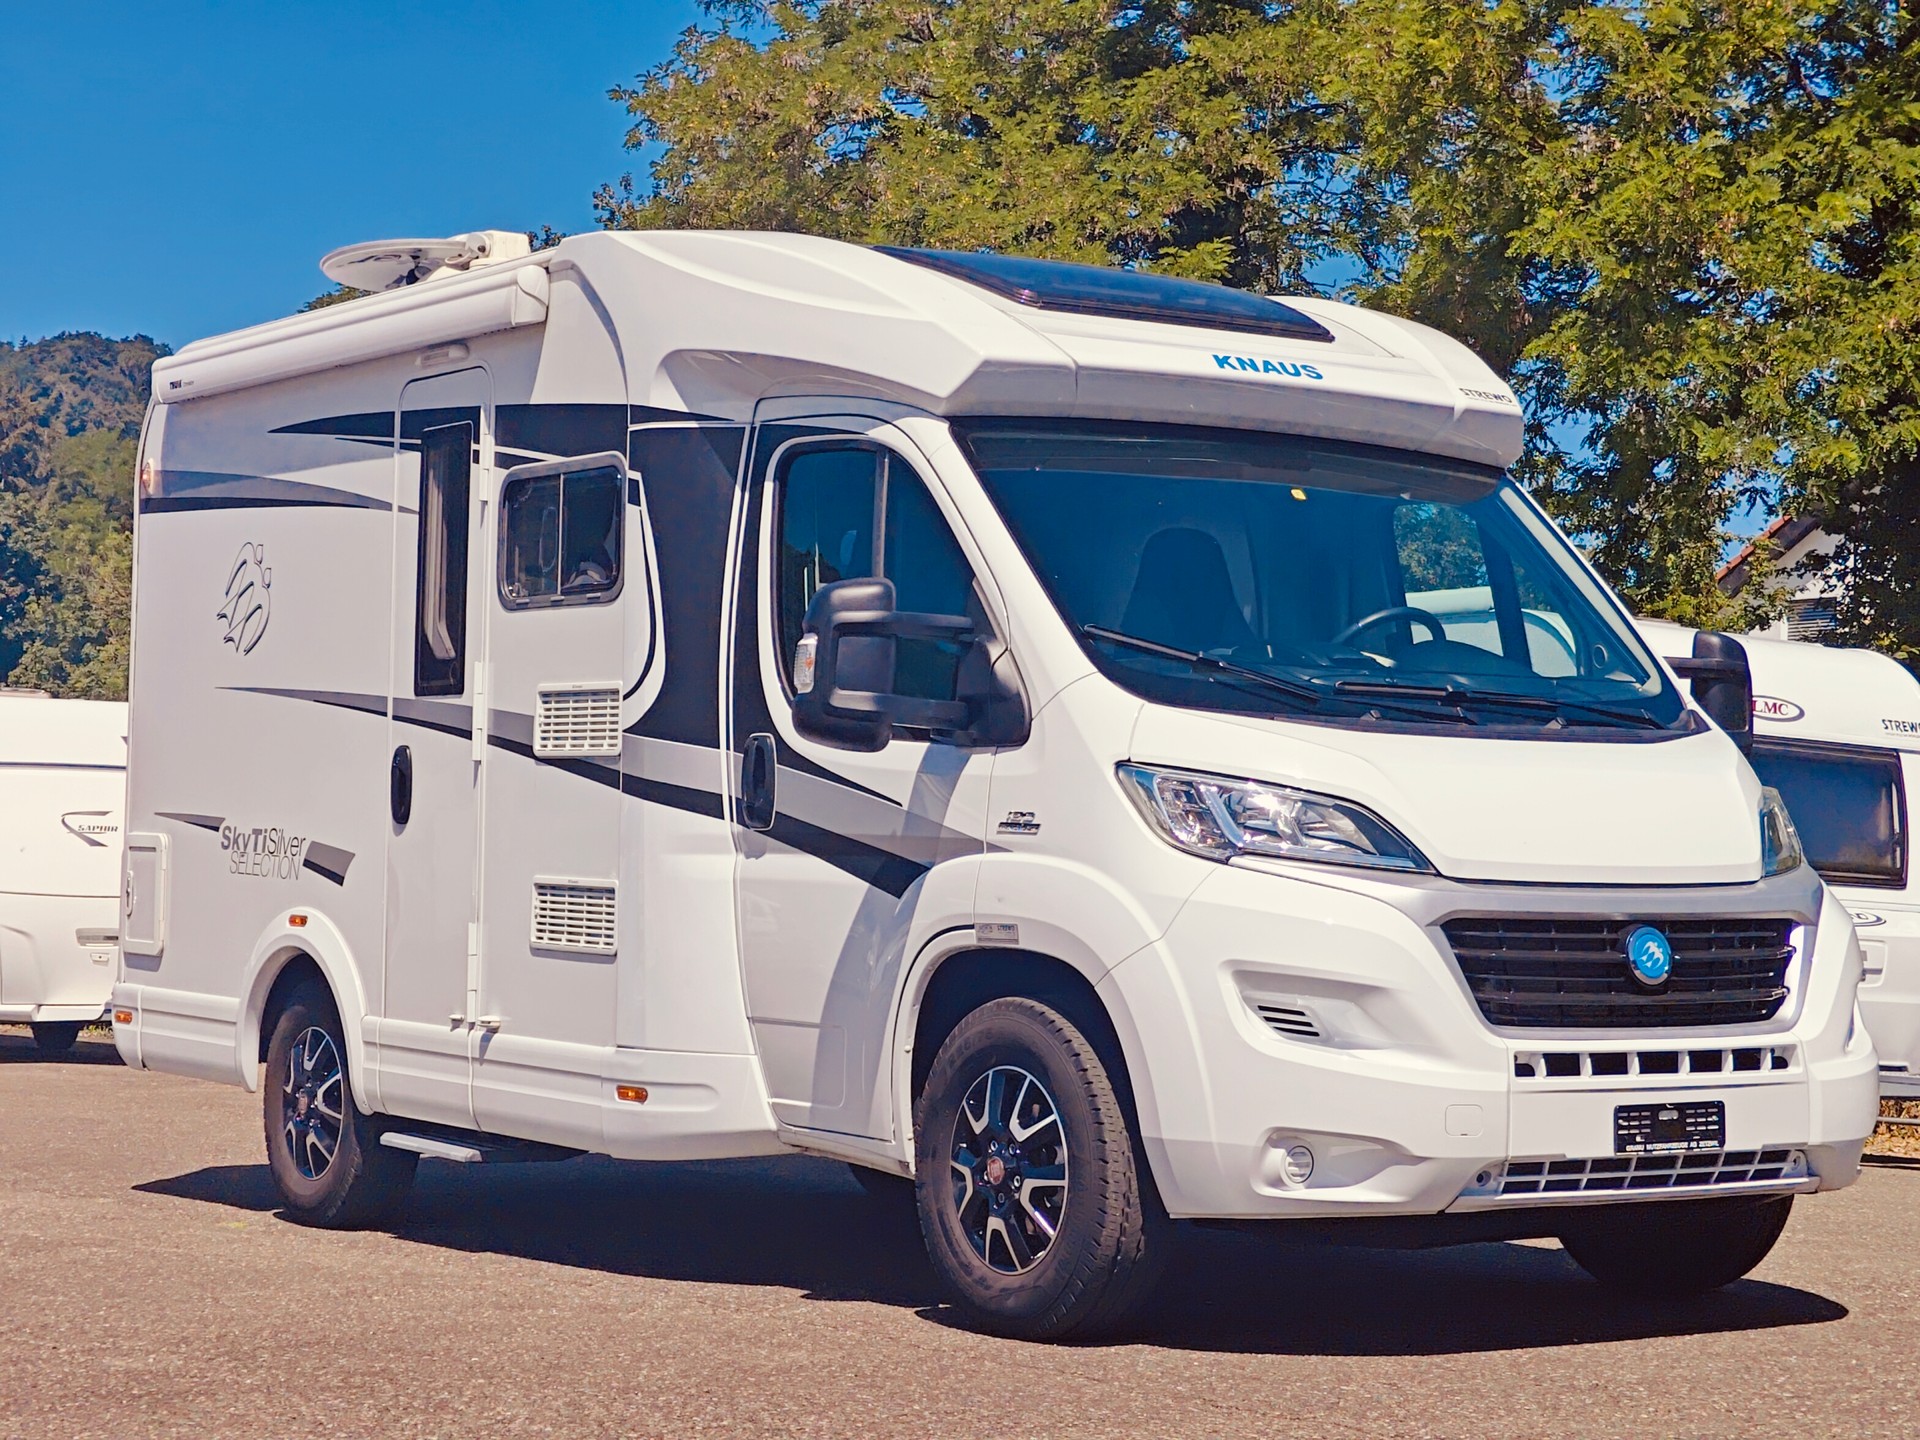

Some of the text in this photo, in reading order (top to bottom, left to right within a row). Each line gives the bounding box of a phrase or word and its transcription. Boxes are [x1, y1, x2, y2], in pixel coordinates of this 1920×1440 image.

[1212, 354, 1324, 380] KNAUS
[1459, 388, 1512, 403] STREWO
[1752, 700, 1789, 716] LMC
[1881, 719, 1920, 733] STREW
[229, 850, 300, 880] SELECTION
